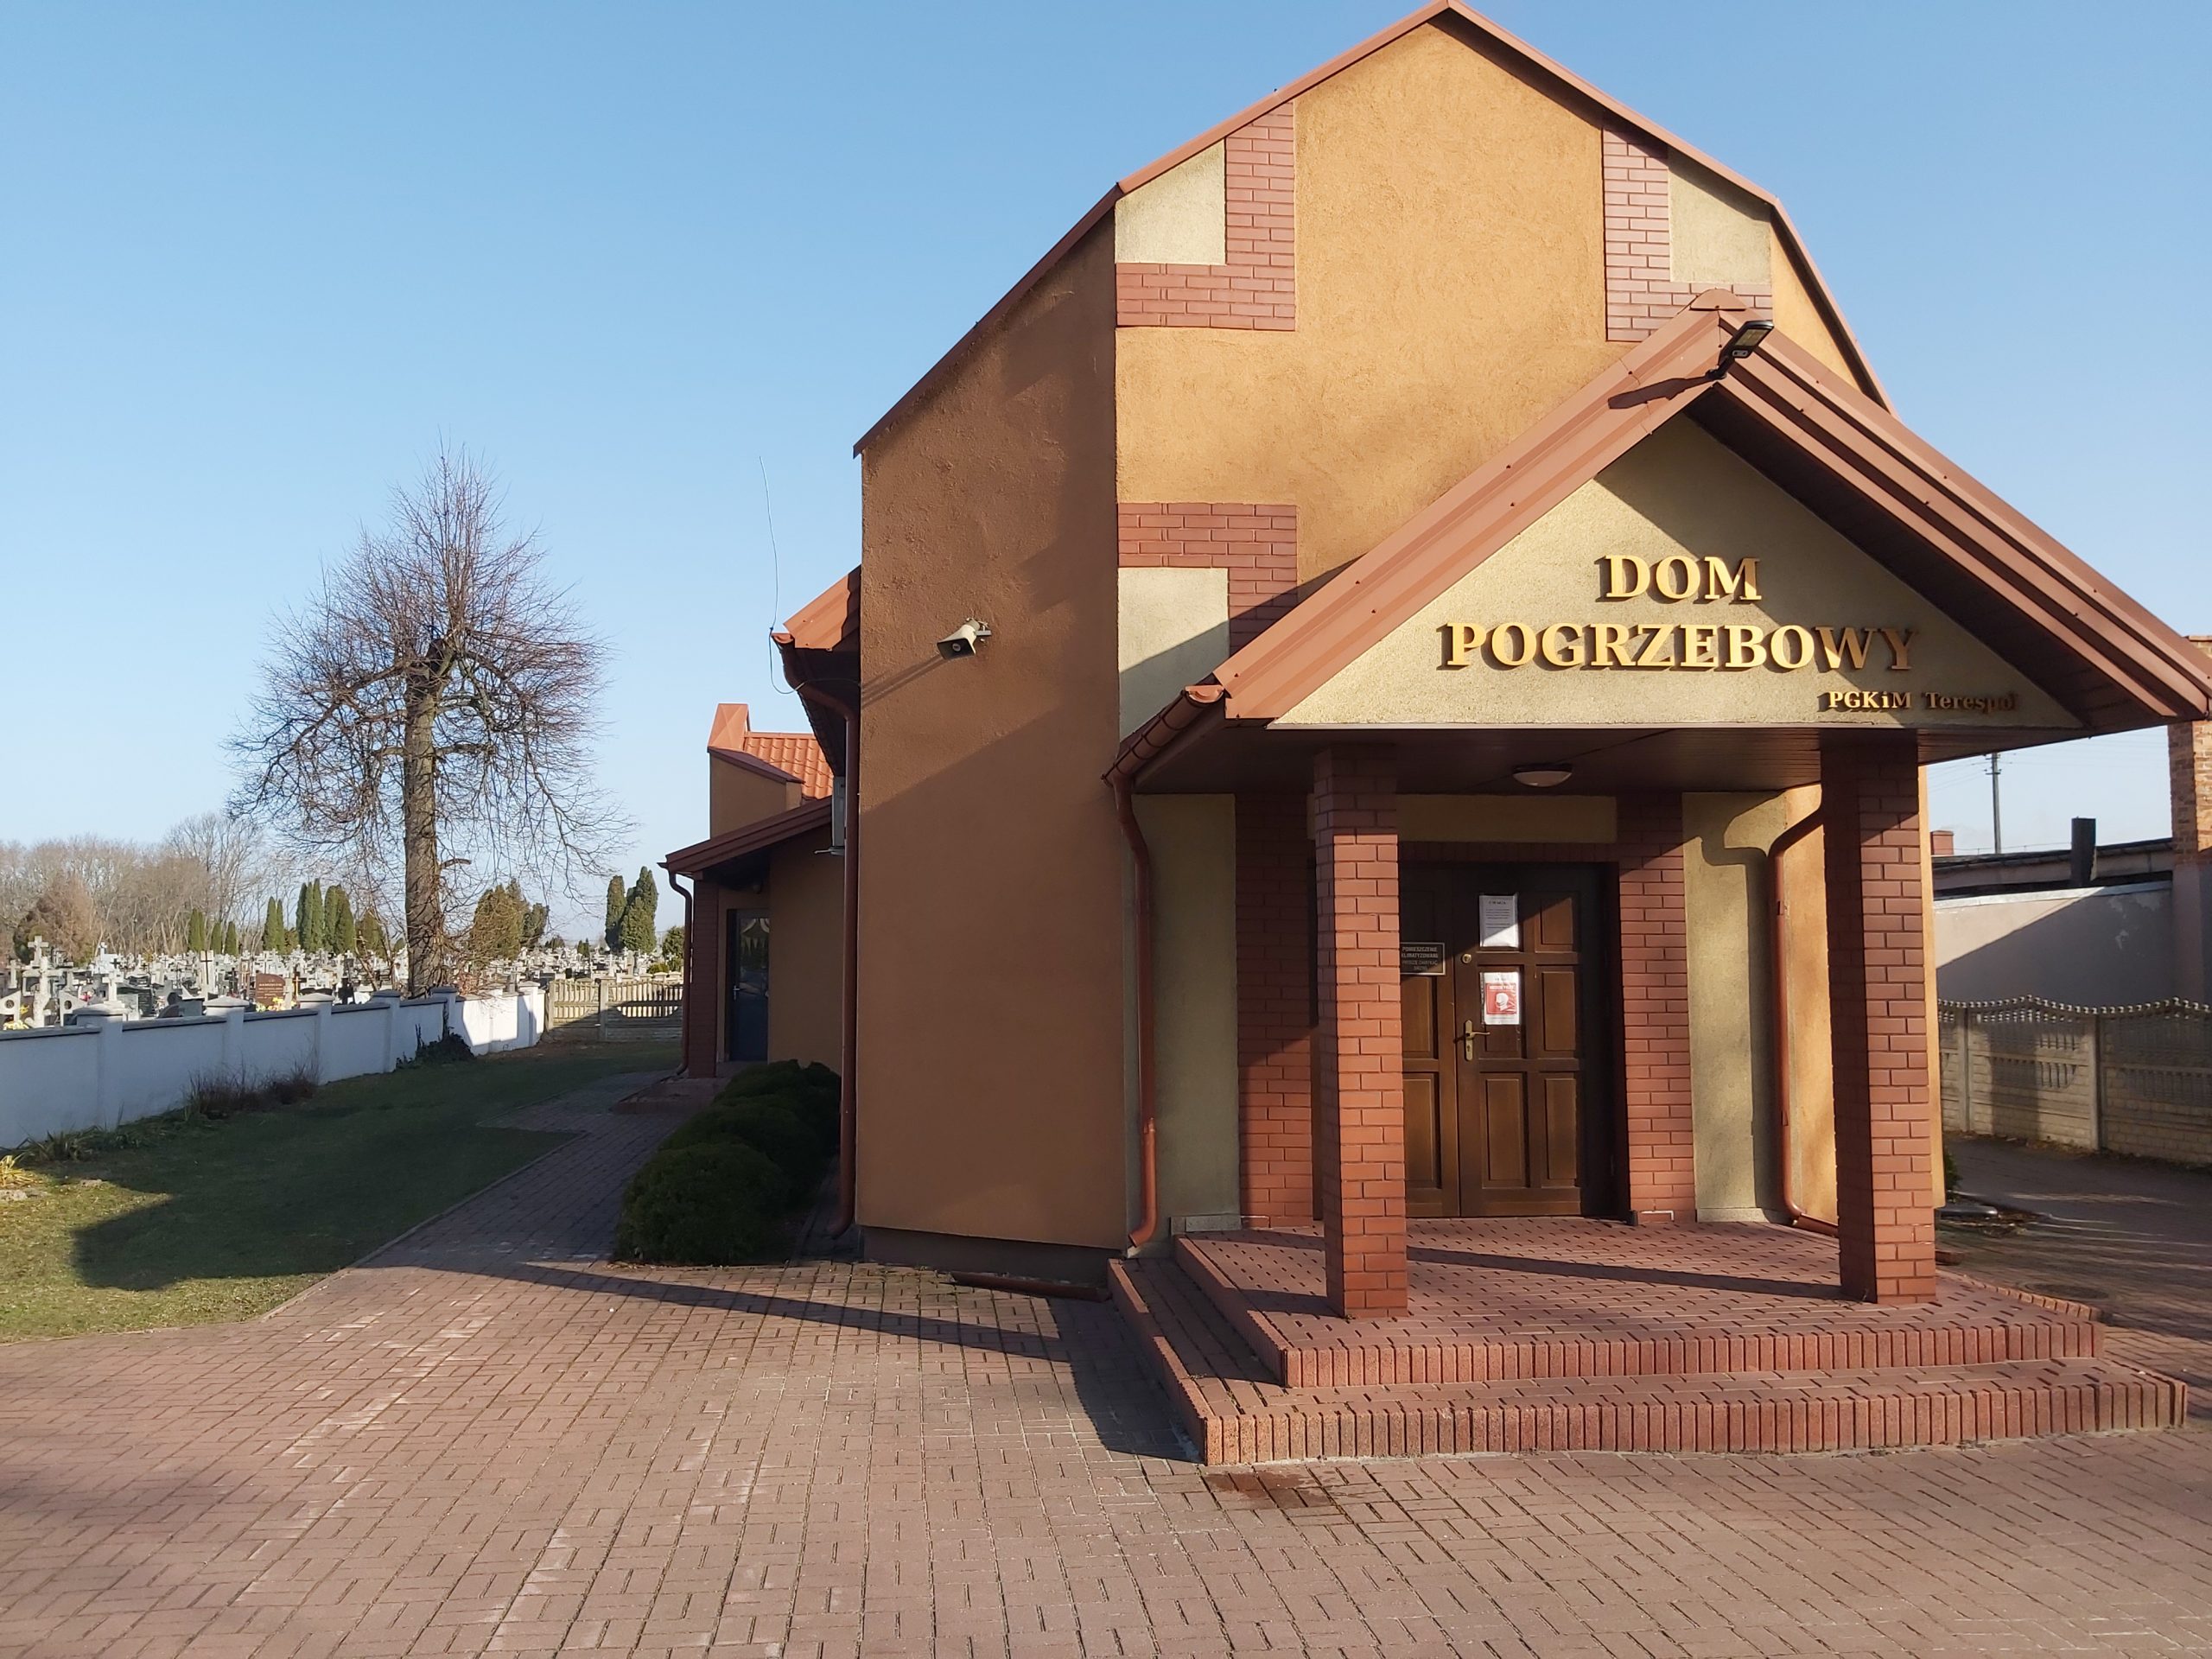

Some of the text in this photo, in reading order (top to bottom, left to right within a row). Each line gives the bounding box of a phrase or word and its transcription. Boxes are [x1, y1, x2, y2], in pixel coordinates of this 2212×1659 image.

[1604, 553, 1762, 601] DOM
[1446, 620, 1918, 671] POGRZEBOWY
[1827, 690, 2019, 715] PGKiM Terespol
